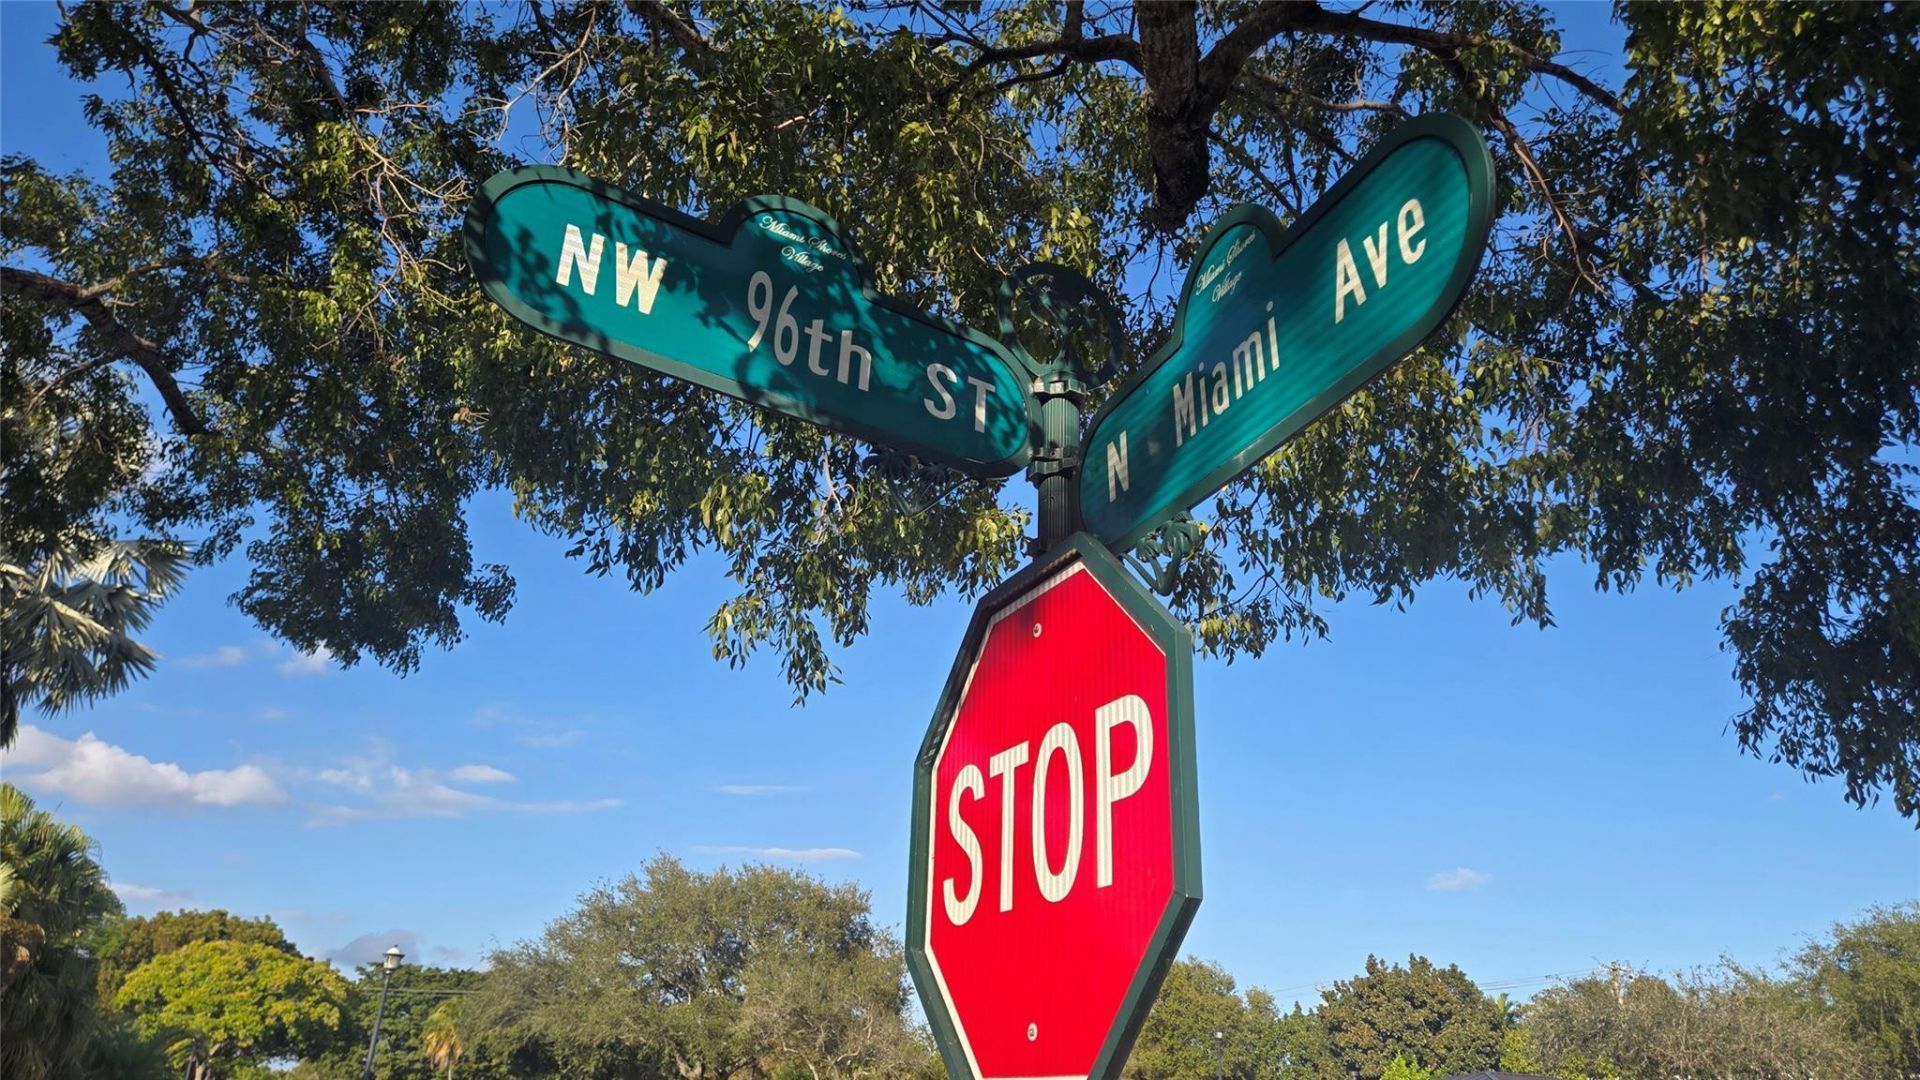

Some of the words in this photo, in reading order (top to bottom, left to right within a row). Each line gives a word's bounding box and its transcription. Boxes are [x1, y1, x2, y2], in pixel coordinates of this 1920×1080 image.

[556, 223, 668, 315] NW
[747, 270, 873, 392] 96th
[923, 363, 996, 433] ST
[760, 215, 806, 243] Miami
[1106, 430, 1130, 503] N
[1172, 301, 1281, 448] Miami
[1335, 198, 1428, 324] Ave
[943, 694, 1154, 926] STOP
